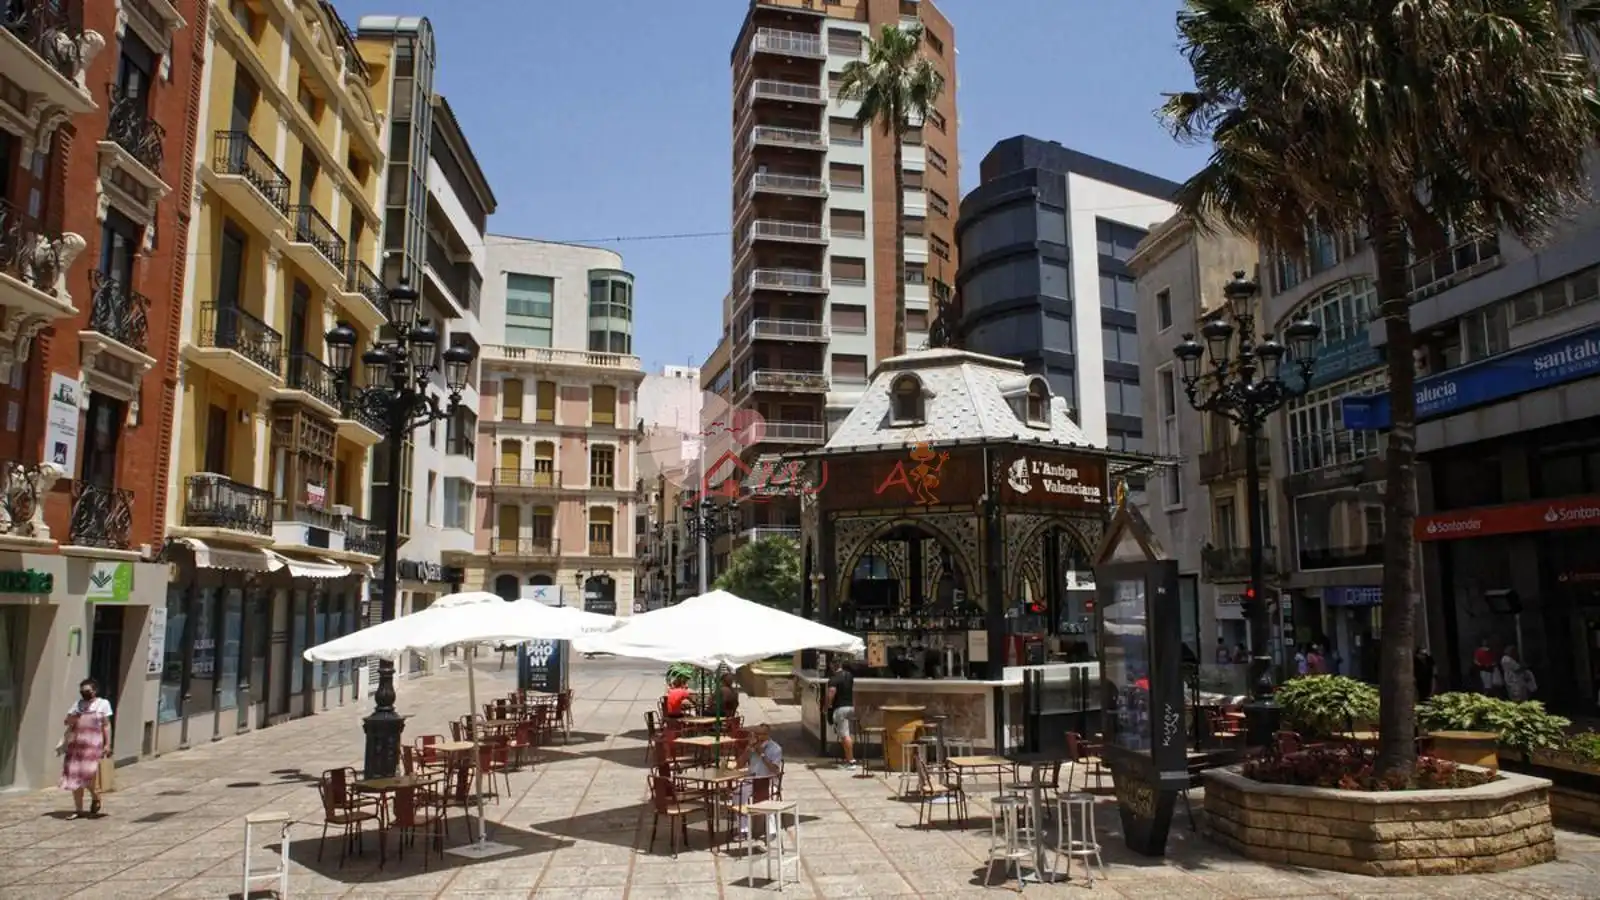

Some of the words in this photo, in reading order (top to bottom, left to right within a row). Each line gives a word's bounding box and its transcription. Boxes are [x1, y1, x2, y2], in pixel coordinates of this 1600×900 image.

[1031, 460, 1079, 480] L'Antiga
[1042, 479, 1101, 497] Valenciana
[1437, 519, 1482, 532] Santander
[526, 646, 552, 656] PHO
[530, 655, 548, 667] NY
